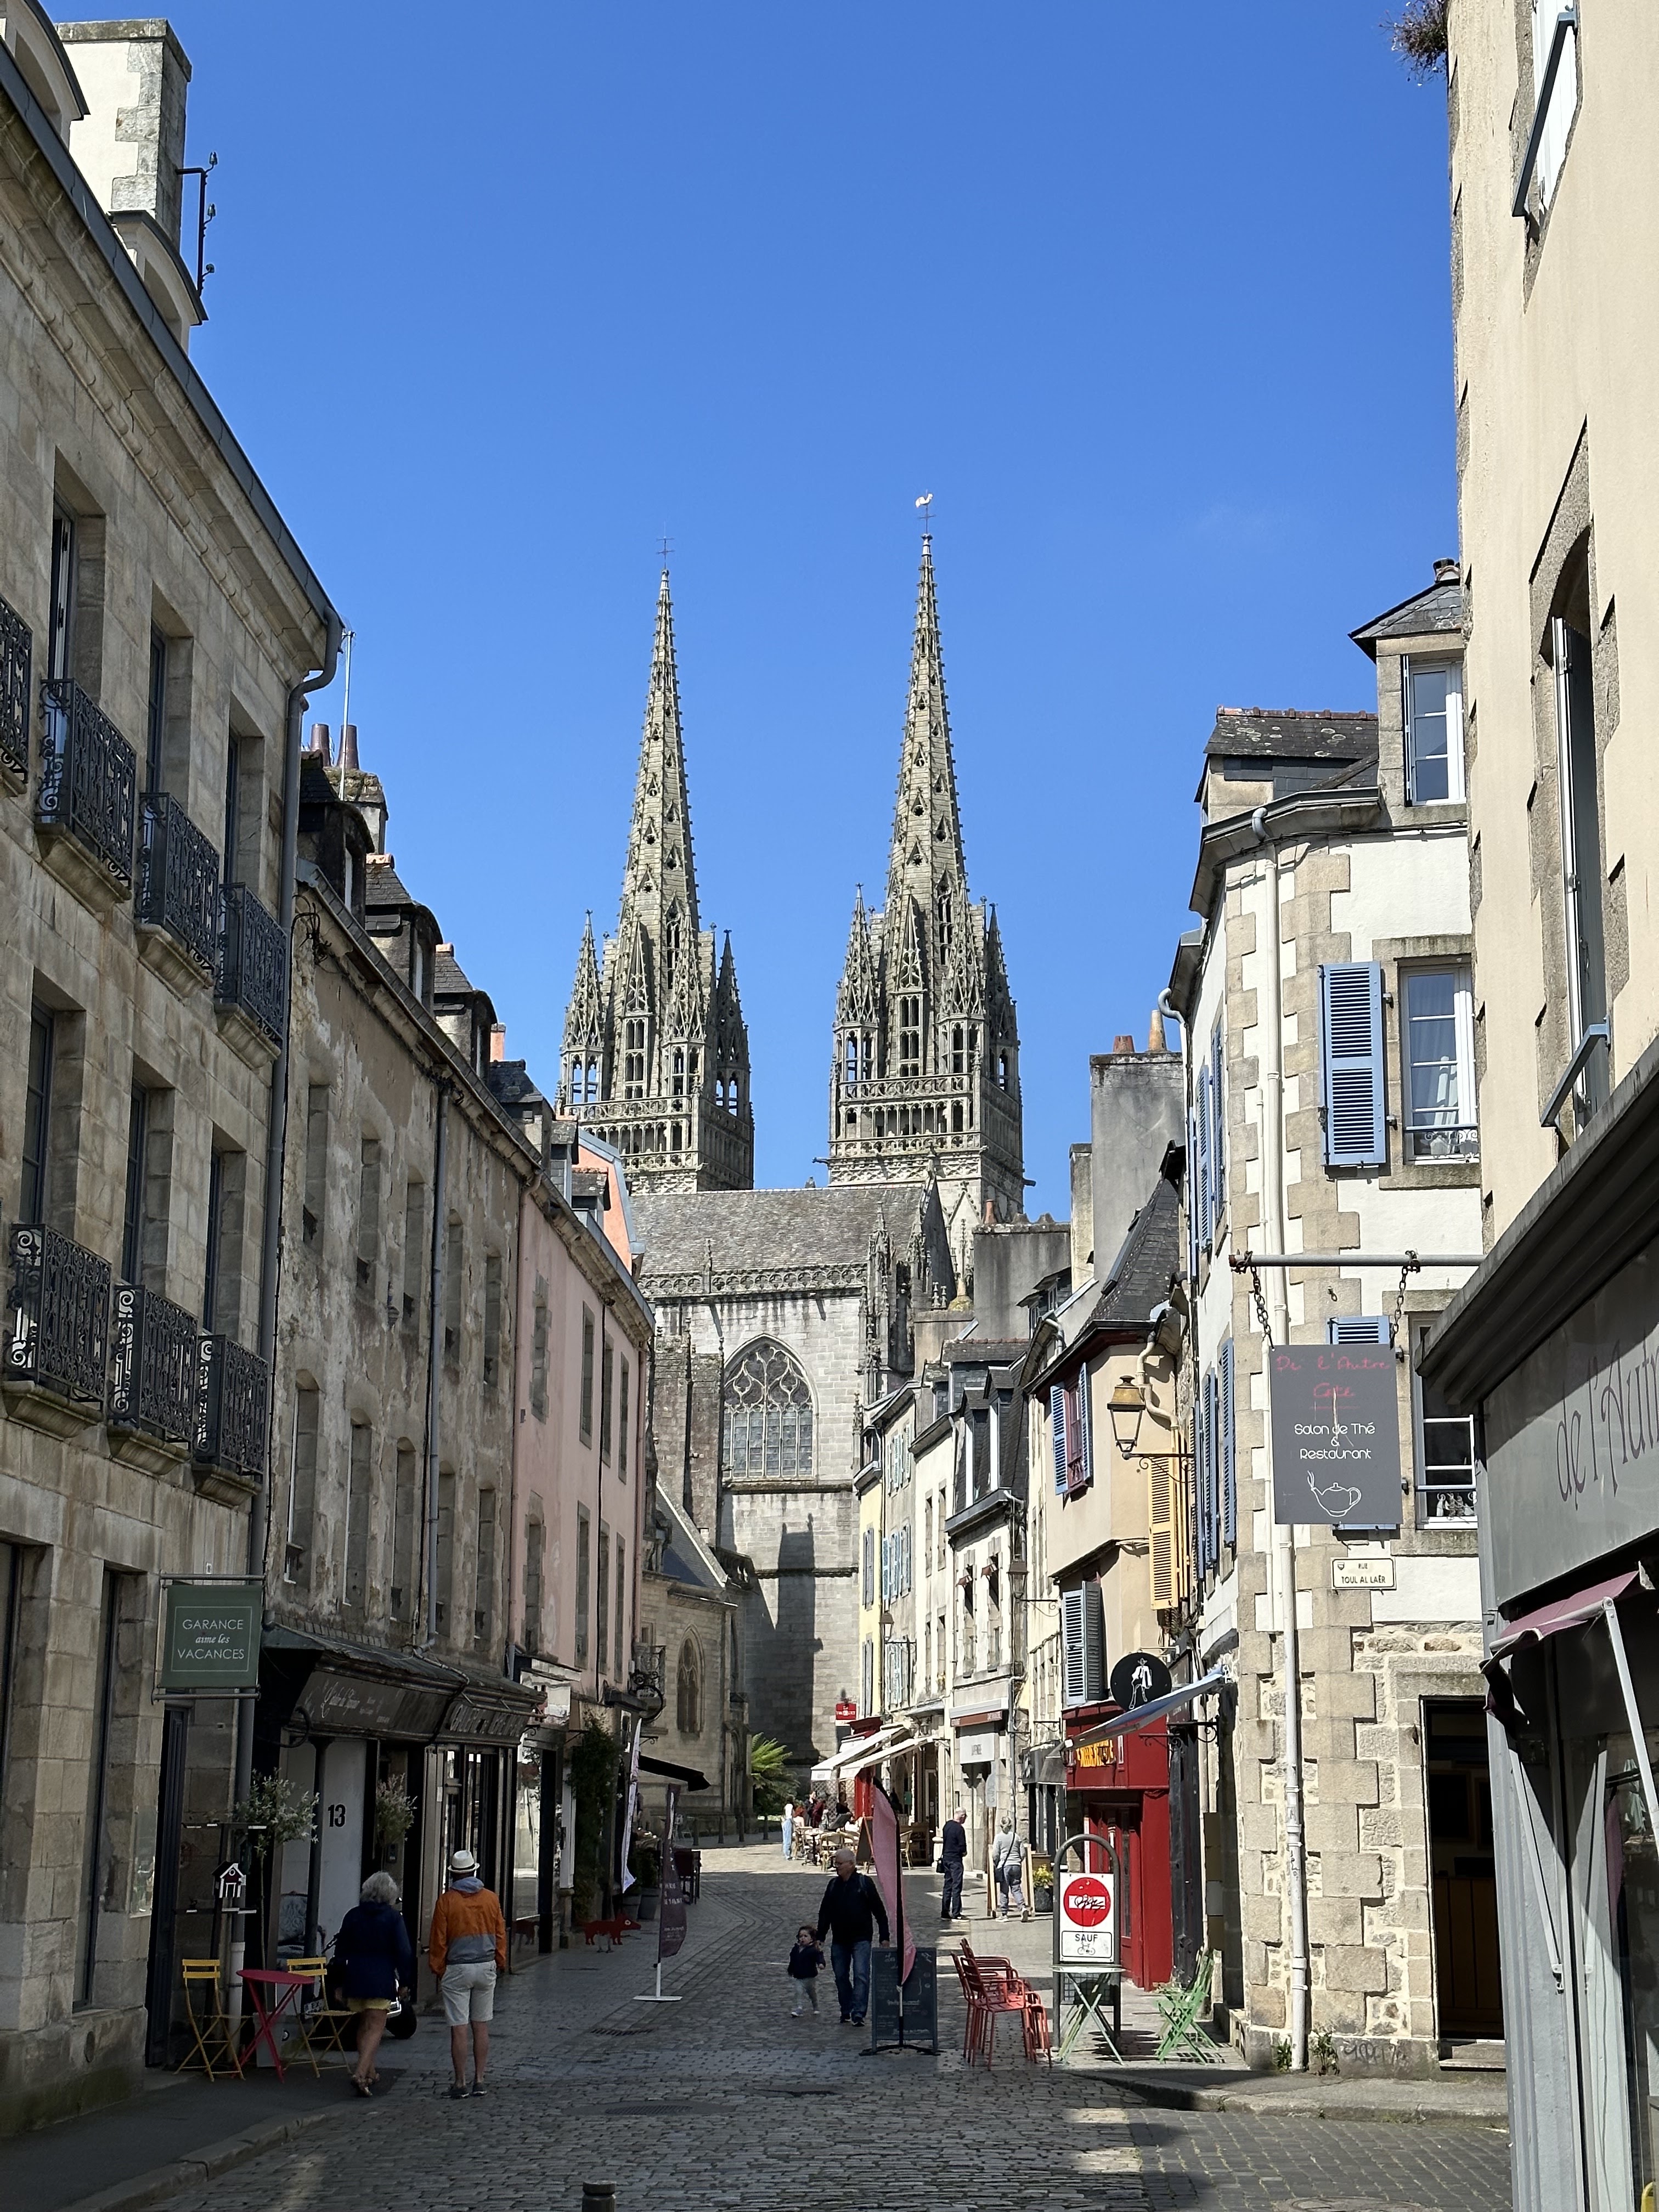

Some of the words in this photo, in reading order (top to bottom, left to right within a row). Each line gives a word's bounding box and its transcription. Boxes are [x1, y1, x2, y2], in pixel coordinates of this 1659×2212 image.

[1294, 1424, 1330, 1435] Salon
[1331, 1424, 1348, 1435] de
[1351, 1421, 1375, 1435] Thé
[1330, 1436, 1340, 1447] &
[1556, 1380, 1587, 1511] de
[1300, 1448, 1372, 1460] Restaurant
[1341, 1576, 1358, 1584] TOUL
[182, 1619, 244, 1630] GARANCE
[195, 1633, 217, 1644] aime
[218, 1633, 230, 1644] les
[177, 1648, 245, 1660] VACANCES
[328, 1804, 346, 1827] 13
[1075, 1933, 1098, 1942] SAUF
